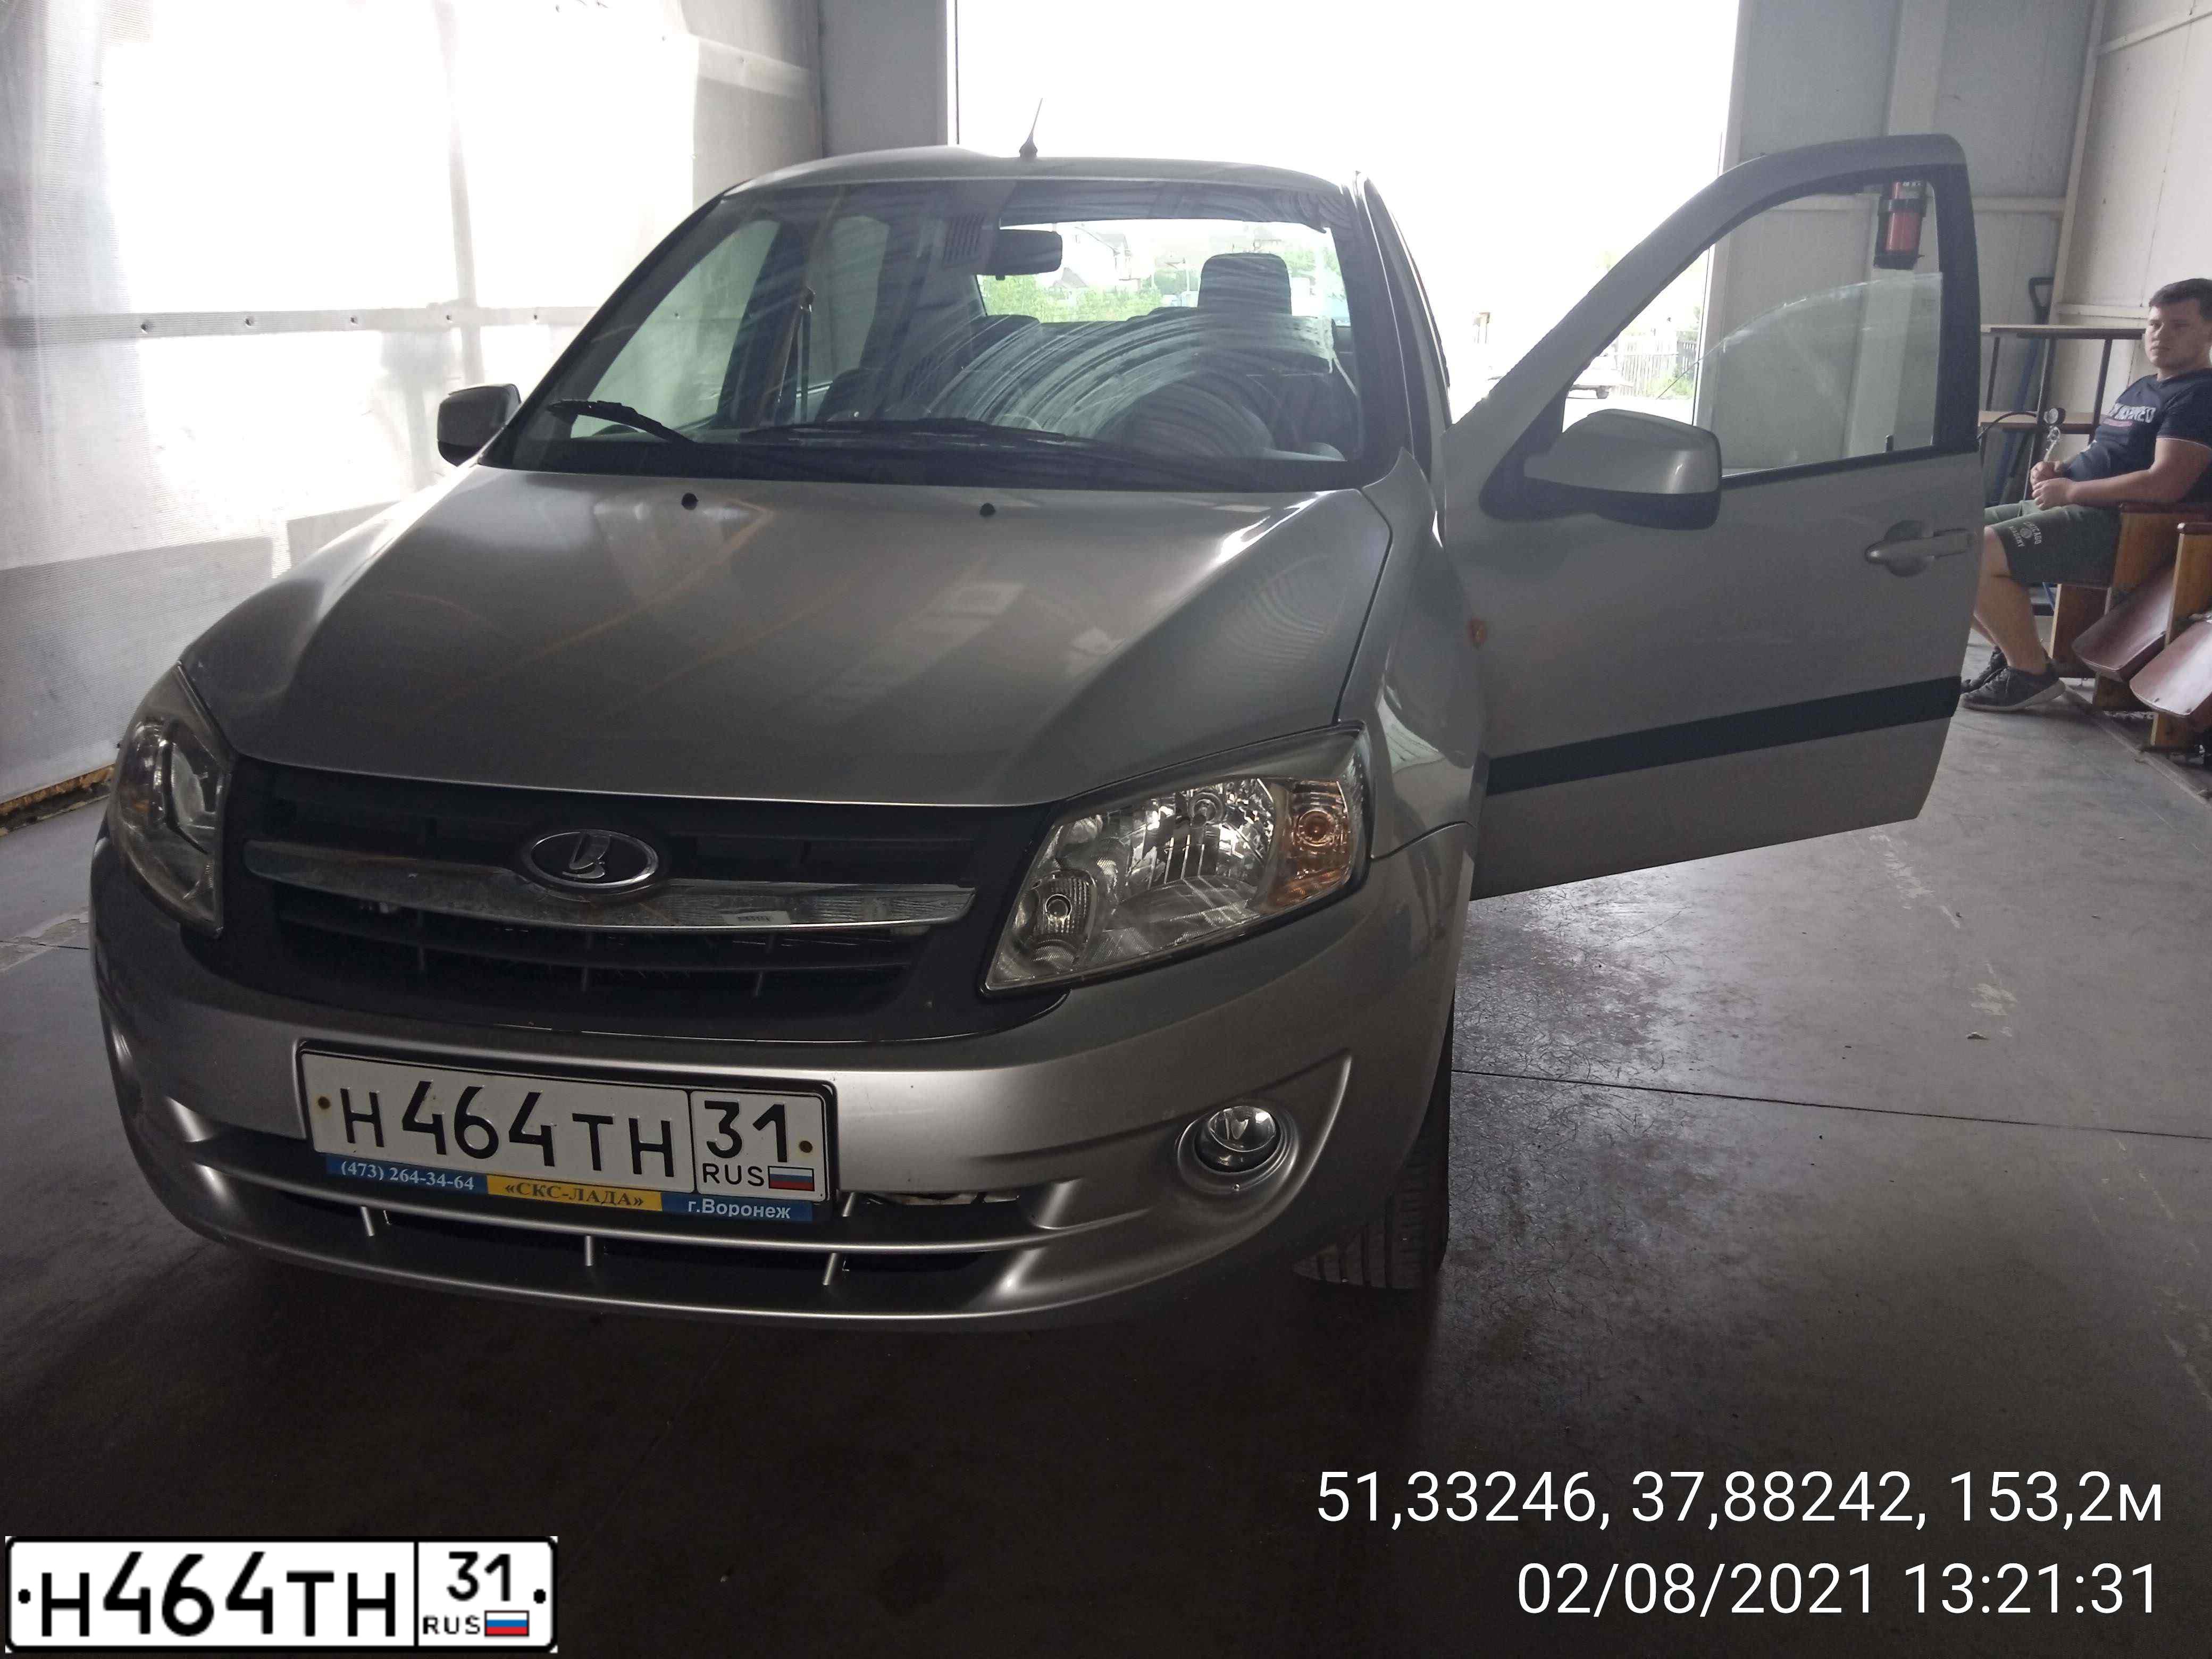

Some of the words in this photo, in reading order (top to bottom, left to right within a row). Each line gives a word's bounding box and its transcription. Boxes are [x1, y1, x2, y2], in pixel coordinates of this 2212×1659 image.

[704, 1100, 787, 1163] 31
[341, 1161, 384, 1180] (473)
[389, 1167, 474, 1190] 264-34-64
[505, 1182, 644, 1206] «СКС-ЛАДА»
[688, 1198, 791, 1219] г.Воронеж
[702, 1163, 765, 1187] RUS
